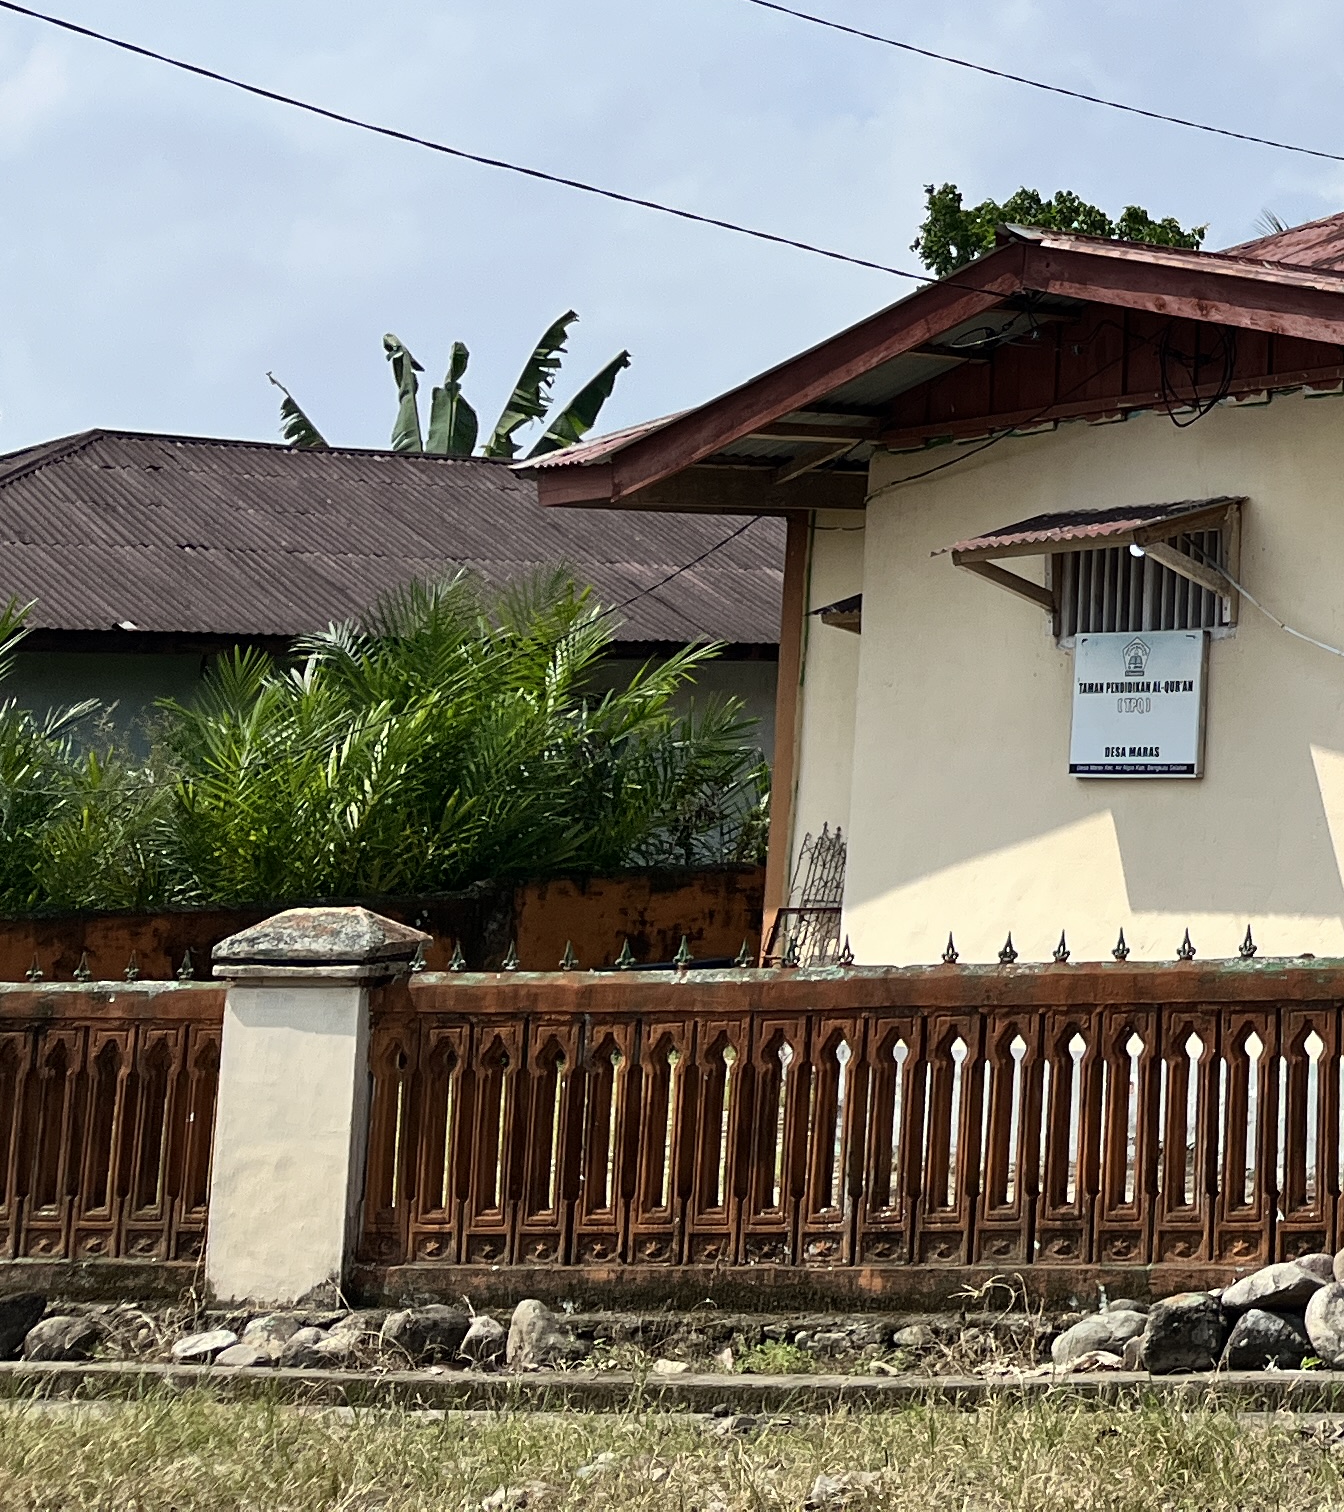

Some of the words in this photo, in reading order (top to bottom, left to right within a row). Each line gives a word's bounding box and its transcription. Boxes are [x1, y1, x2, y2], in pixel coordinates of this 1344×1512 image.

[1079, 682, 1104, 694] TAMAN
[1106, 681, 1151, 694] PENDIDIKAN
[1104, 746, 1127, 758] DESA
[1128, 746, 1160, 758] MARAS
